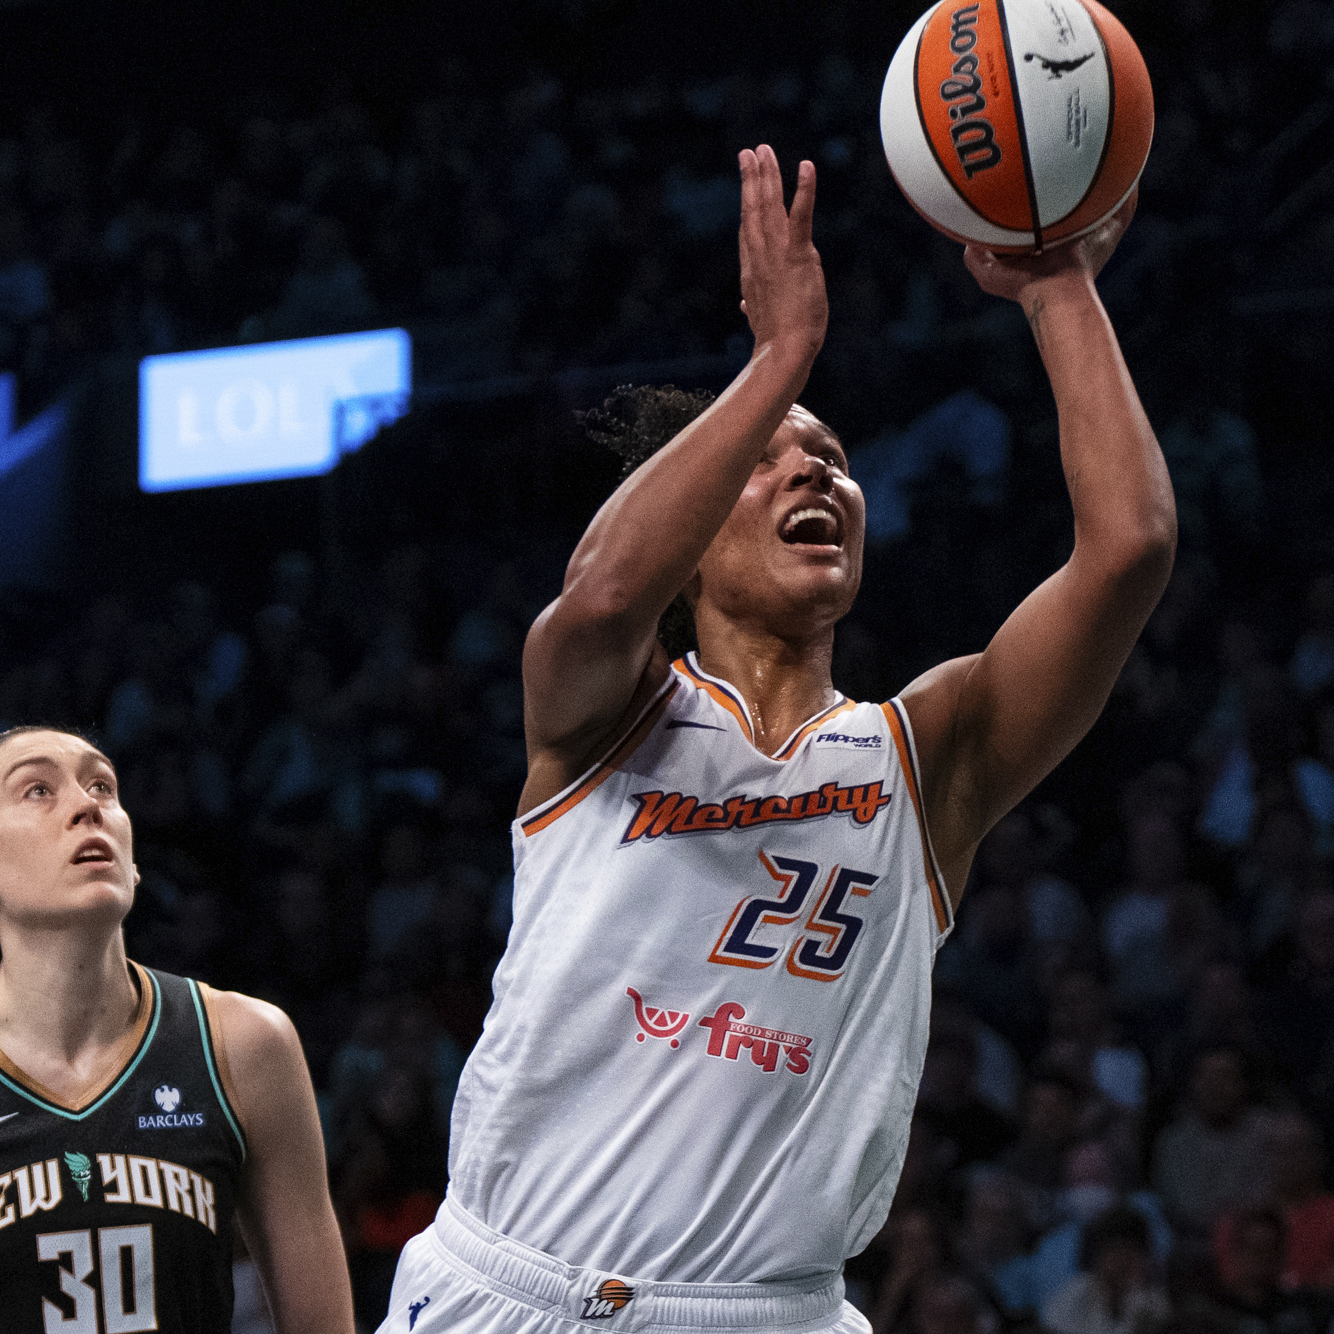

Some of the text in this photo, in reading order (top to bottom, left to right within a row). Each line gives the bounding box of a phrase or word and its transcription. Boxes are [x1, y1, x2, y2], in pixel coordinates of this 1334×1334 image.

[938, 2, 1003, 180] Wilson
[176, 374, 357, 448] LOL
[617, 780, 892, 847] Mercury
[707, 850, 880, 983] 25
[698, 1001, 813, 1075] fry's
[729, 1022, 808, 1047] FOOD STORES
[138, 1111, 204, 1130] BARCLAYS
[95, 1153, 219, 1236] YORK
